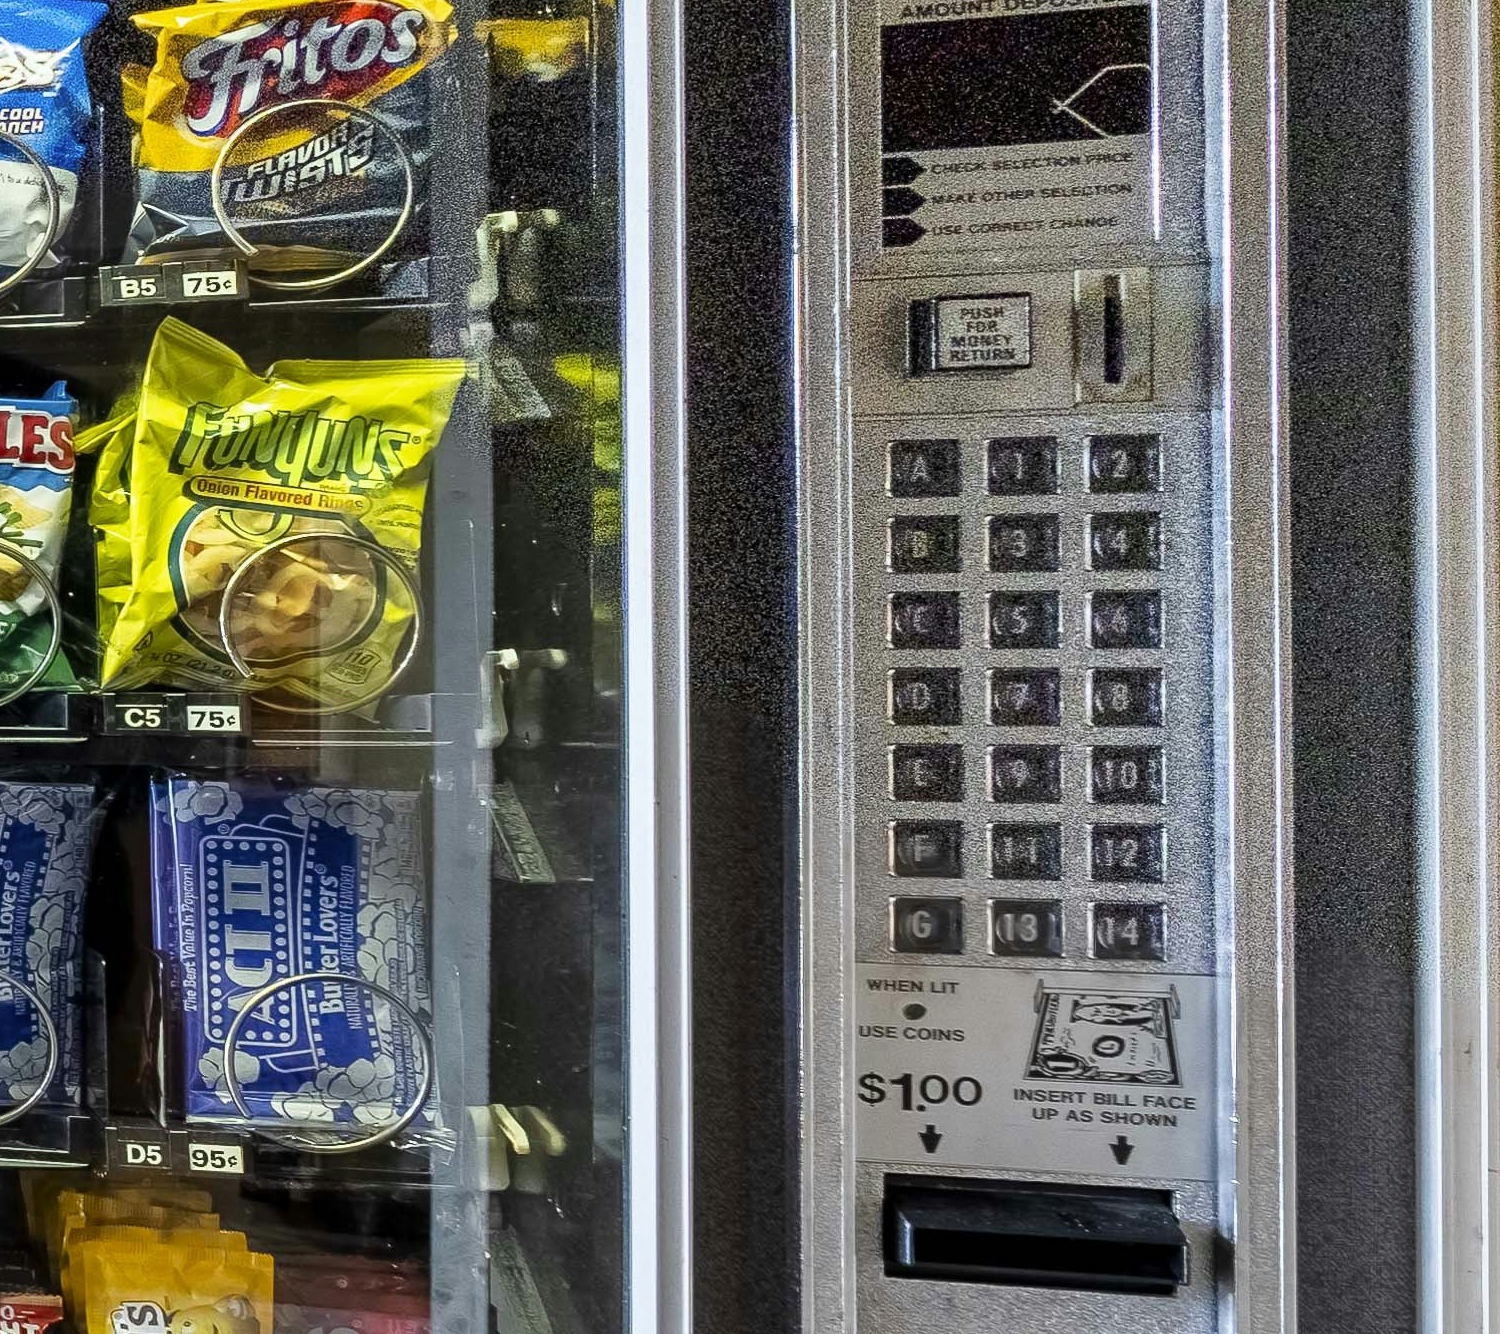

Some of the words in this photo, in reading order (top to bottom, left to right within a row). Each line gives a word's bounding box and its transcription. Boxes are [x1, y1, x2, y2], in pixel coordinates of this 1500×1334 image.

[901, 0, 999, 17] AMOUNT
[183, 10, 423, 136] Fritos
[0, 107, 44, 121] COOL
[1085, 152, 1134, 166] PRICE
[979, 189, 1035, 204] OTHER
[1041, 183, 1132, 199] SELECTION
[121, 278, 157, 298] B5
[961, 307, 1004, 320] PUSH
[966, 320, 998, 333] FOR
[950, 334, 1013, 348] MONEY
[950, 348, 1016, 362] RETURN
[911, 454, 931, 480] A
[1110, 451, 1130, 480] 2
[197, 477, 242, 500] Onion
[244, 484, 314, 507] Flavored
[318, 493, 365, 512] Rings
[124, 709, 161, 728] C5
[1105, 759, 1139, 789] 10
[1105, 837, 1139, 867] 12
[179, 863, 199, 912] Popcorn!
[911, 910, 933, 939] G
[1003, 912, 1038, 942] 13
[1104, 915, 1139, 946] 14
[181, 928, 197, 963] Value
[182, 964, 197, 991] Best
[225, 924, 276, 1026] ACT
[866, 978, 924, 993] WHEN
[930, 981, 960, 994] LIT
[859, 1024, 900, 1040] USE
[903, 1026, 966, 1043] COINS
[858, 1071, 983, 1113] $1.00
[1013, 1088, 1087, 1105] INSERT
[1093, 1091, 1136, 1108] BILL
[1143, 1094, 1197, 1110] FACE
[1032, 1107, 1060, 1122] UP
[1065, 1108, 1093, 1123] AS
[1100, 1110, 1178, 1127] SHOWN
[126, 1144, 162, 1164] D5
